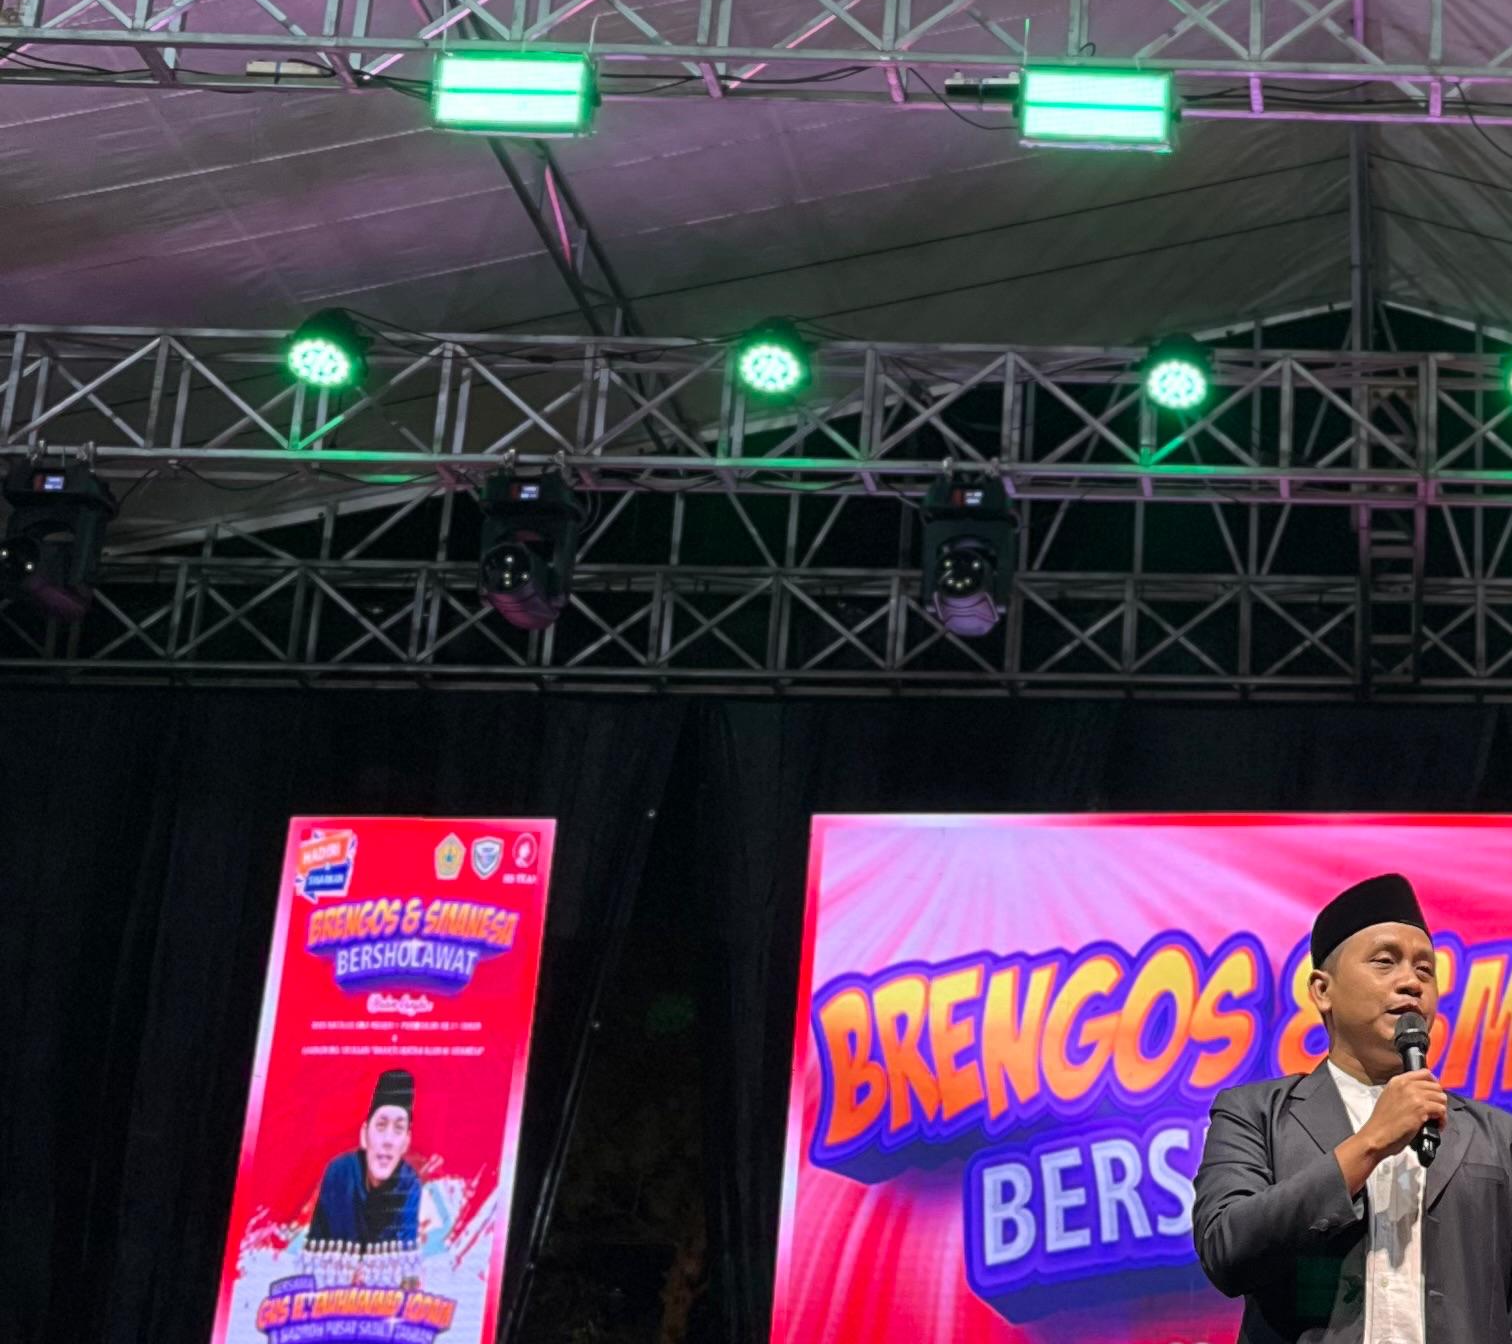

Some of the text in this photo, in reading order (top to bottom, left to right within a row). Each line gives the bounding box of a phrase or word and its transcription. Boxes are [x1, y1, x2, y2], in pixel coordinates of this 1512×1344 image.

[308, 898, 519, 947] BRENGOS & SMANESA
[336, 939, 479, 976] BERSHOLAWAT
[818, 944, 1257, 1147] BRENGOS
